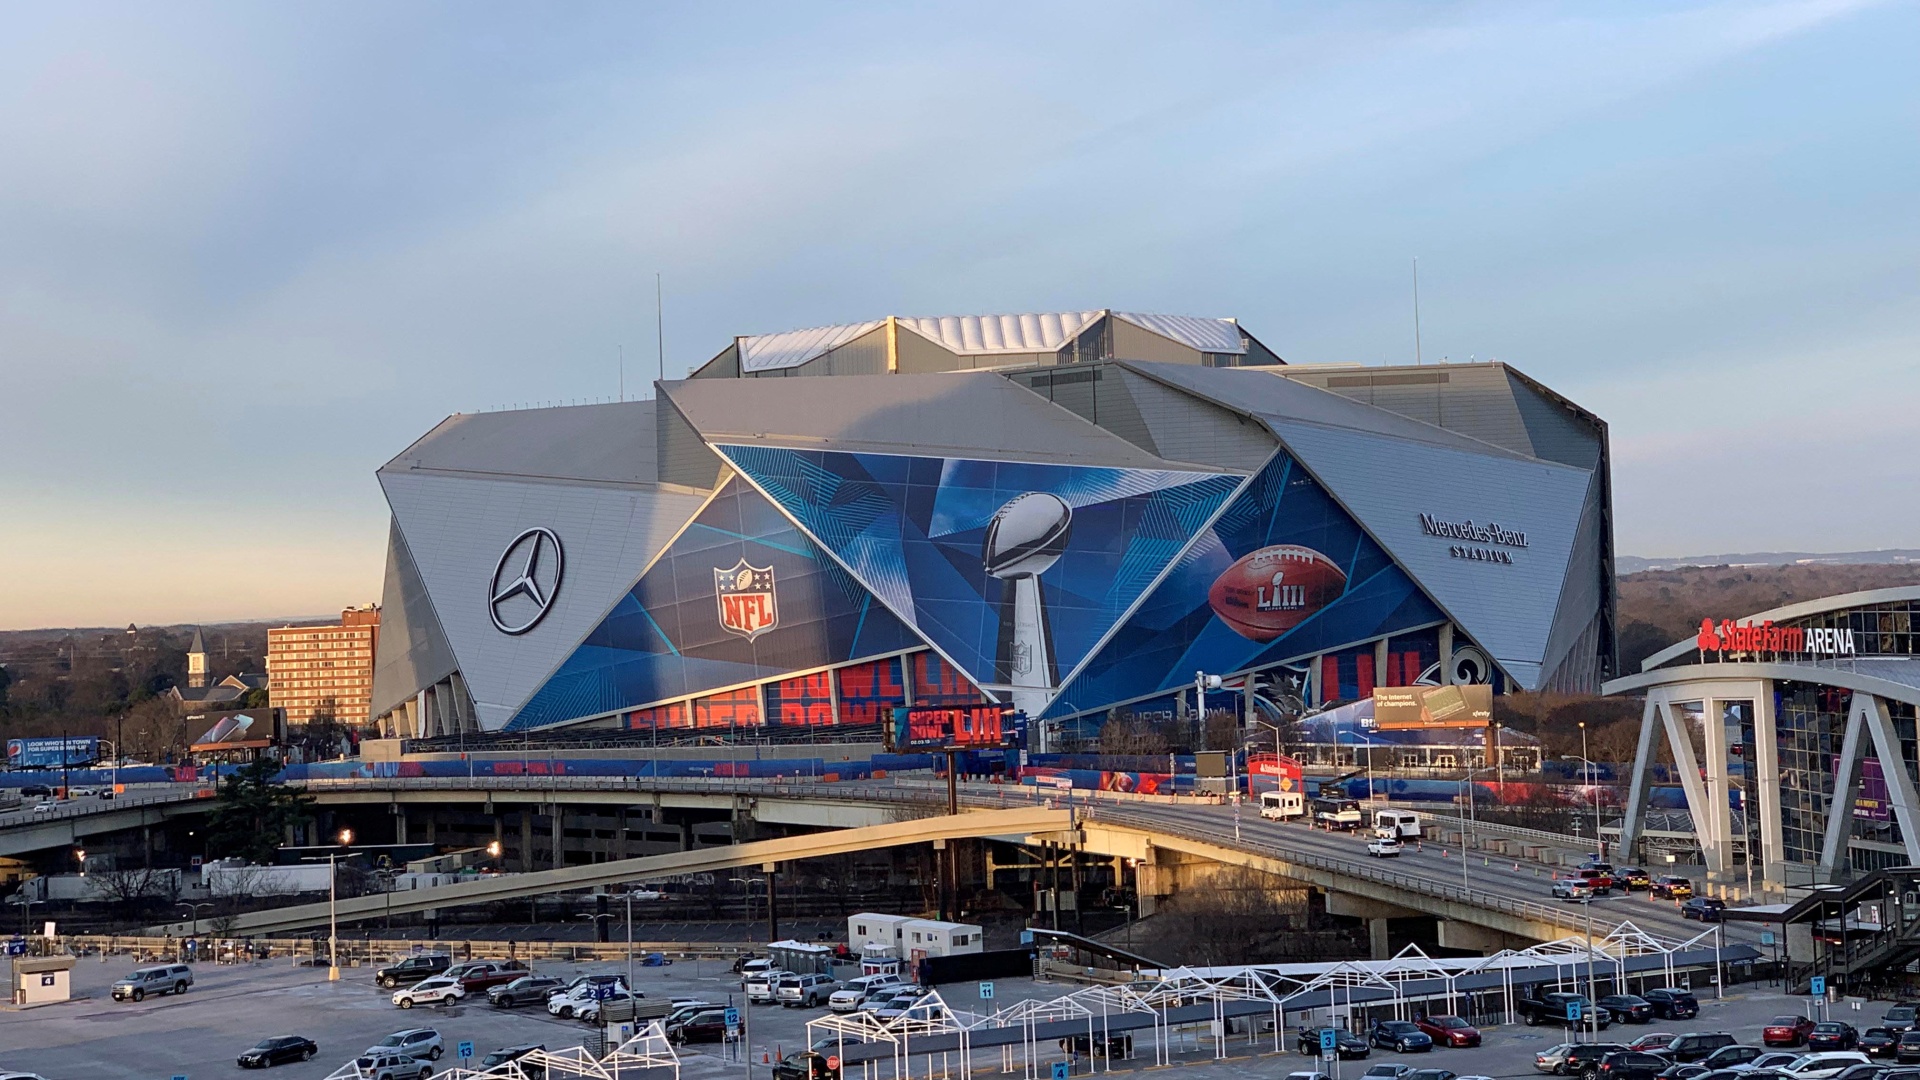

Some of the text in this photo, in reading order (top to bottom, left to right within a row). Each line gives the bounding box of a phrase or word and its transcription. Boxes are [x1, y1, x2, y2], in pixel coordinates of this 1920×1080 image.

[1420, 512, 1530, 547] Mercedes-Benz
[1451, 544, 1514, 564] STADIUM
[1257, 585, 1305, 608] LIII
[723, 594, 772, 631] NFL
[1806, 628, 1856, 654] ARENA
[909, 710, 950, 724] SUPER
[45, 977, 51, 985] 4
[1816, 983, 1821, 992] 1
[590, 989, 596, 998] 2
[603, 988, 611, 998] 2
[982, 989, 992, 997] 11
[727, 1014, 738, 1023] 12
[1571, 1009, 1578, 1018] 2
[1325, 1036, 1332, 1046] 3
[460, 1047, 472, 1057] 13
[1057, 1069, 1064, 1079] 4
